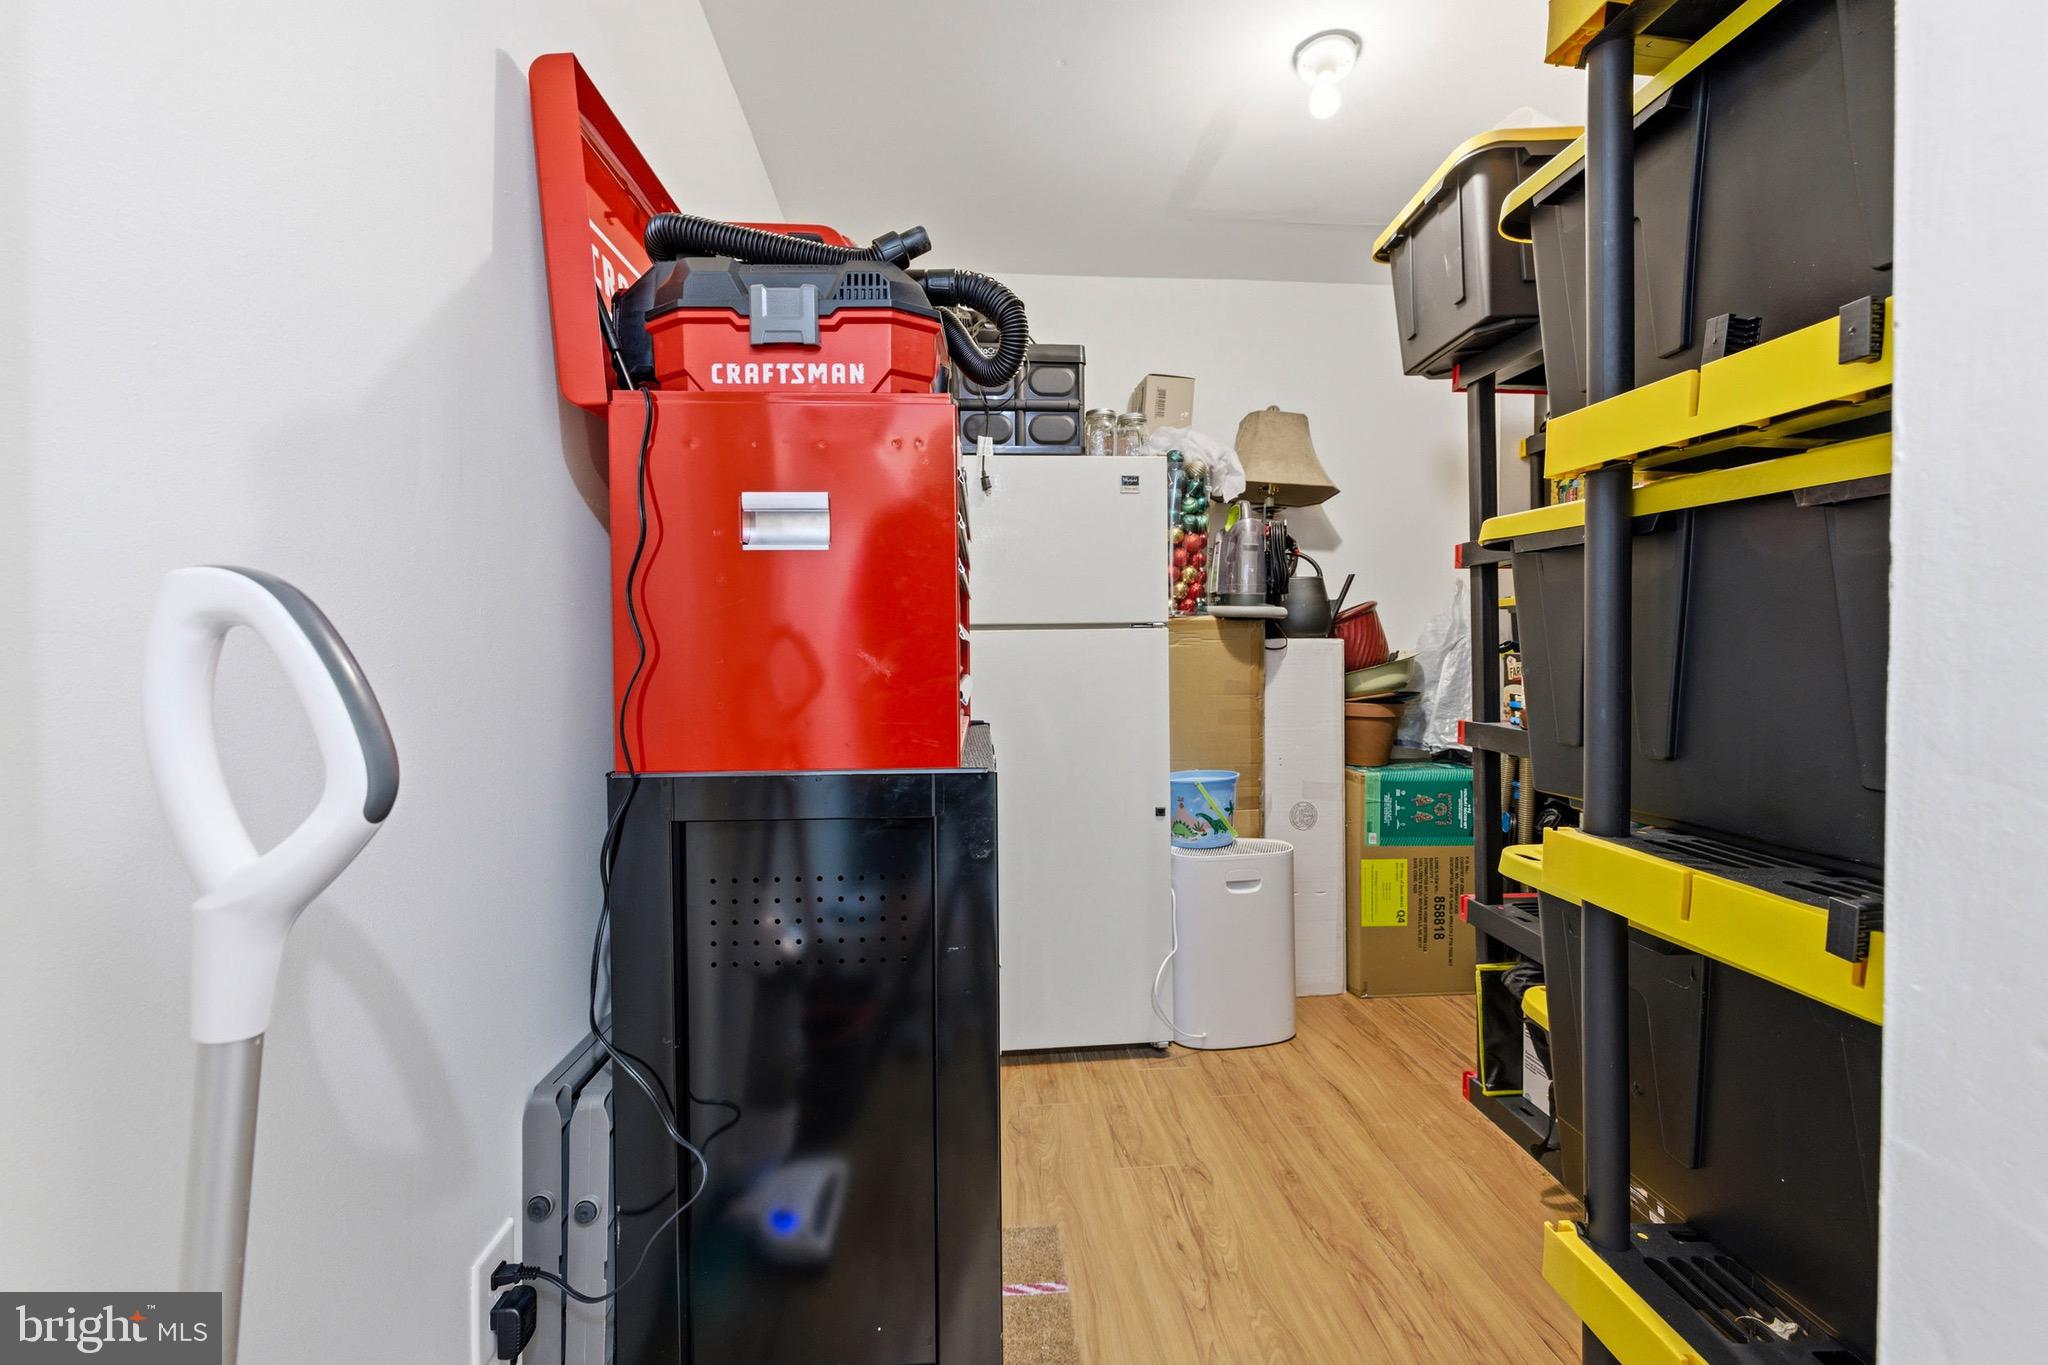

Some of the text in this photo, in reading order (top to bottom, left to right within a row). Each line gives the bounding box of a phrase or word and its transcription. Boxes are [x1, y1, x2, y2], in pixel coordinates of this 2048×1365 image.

[711, 362, 865, 385] CRAFTSMAN
[1396, 910, 1405, 923] Q4
[1434, 896, 1445, 940] 858818
